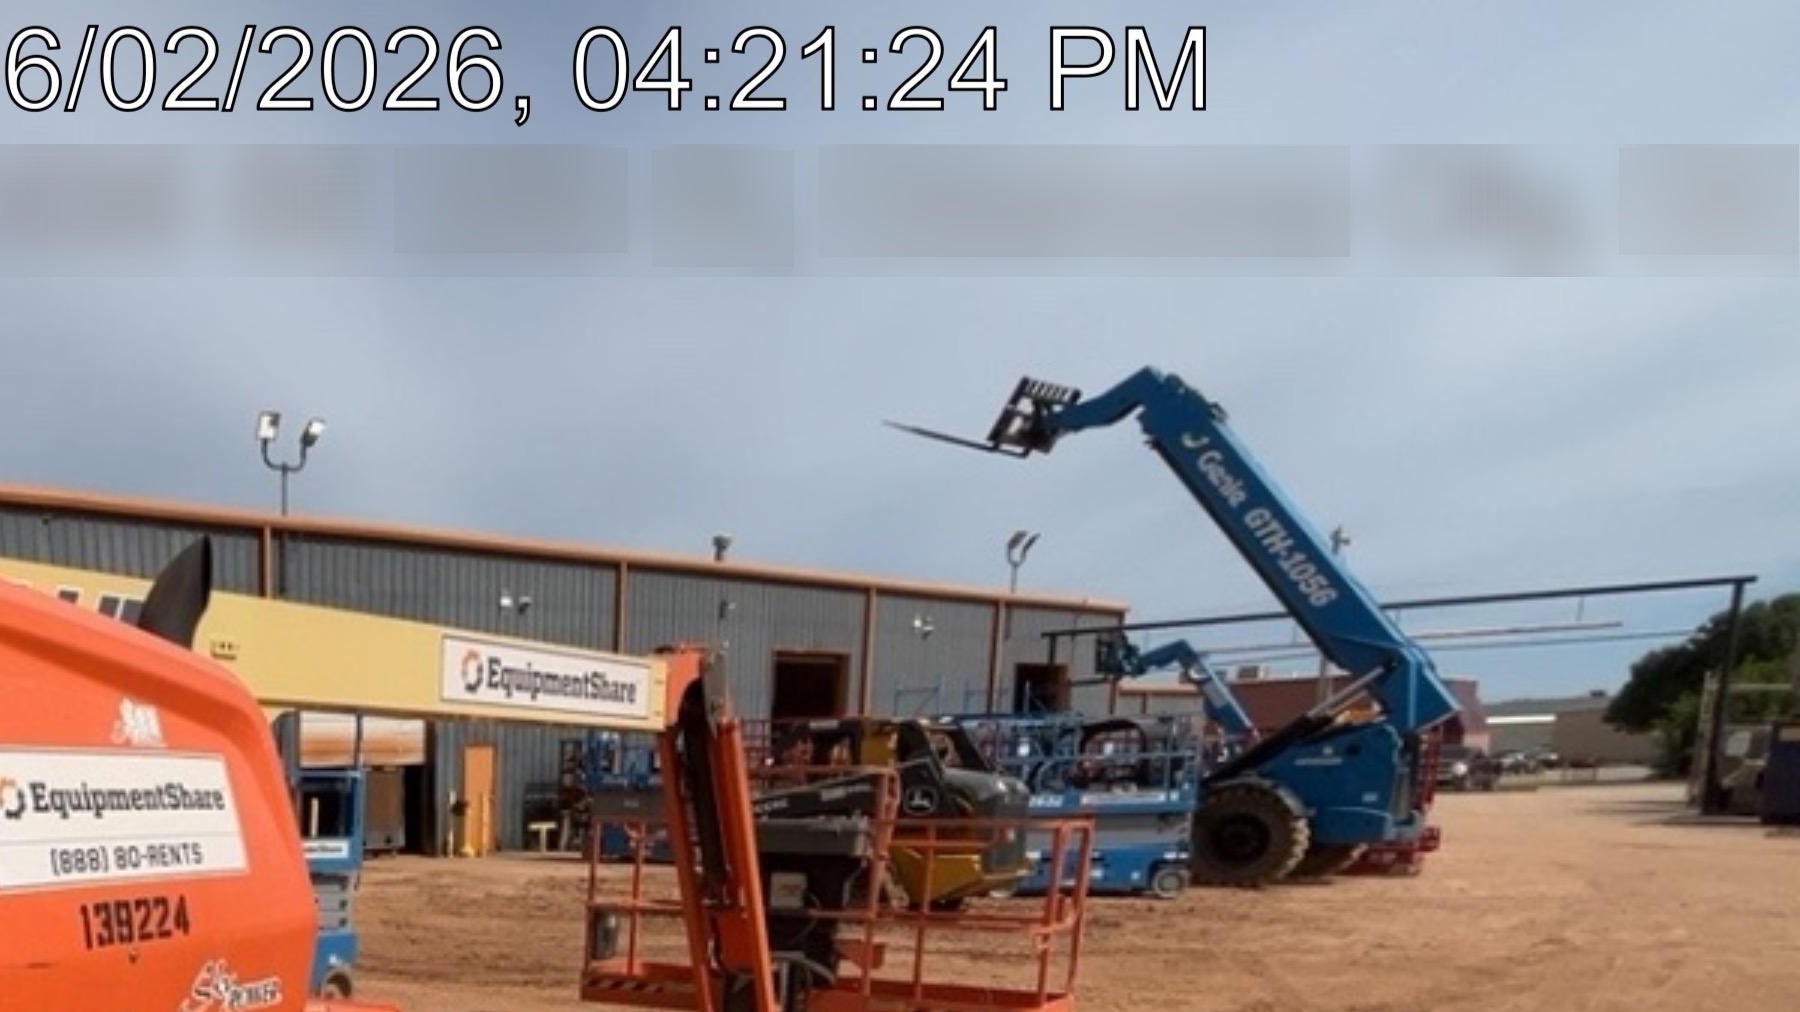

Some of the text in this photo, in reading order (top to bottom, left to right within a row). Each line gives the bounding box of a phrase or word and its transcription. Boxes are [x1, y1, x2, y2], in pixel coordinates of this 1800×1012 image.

[1197, 450, 1339, 608] Genie GTH-1056
[486, 656, 637, 704] EquipmentShare
[28, 781, 226, 820] EquipmentShare
[49, 842, 206, 876] (888) 80-RENTS
[79, 893, 191, 950] 139224
